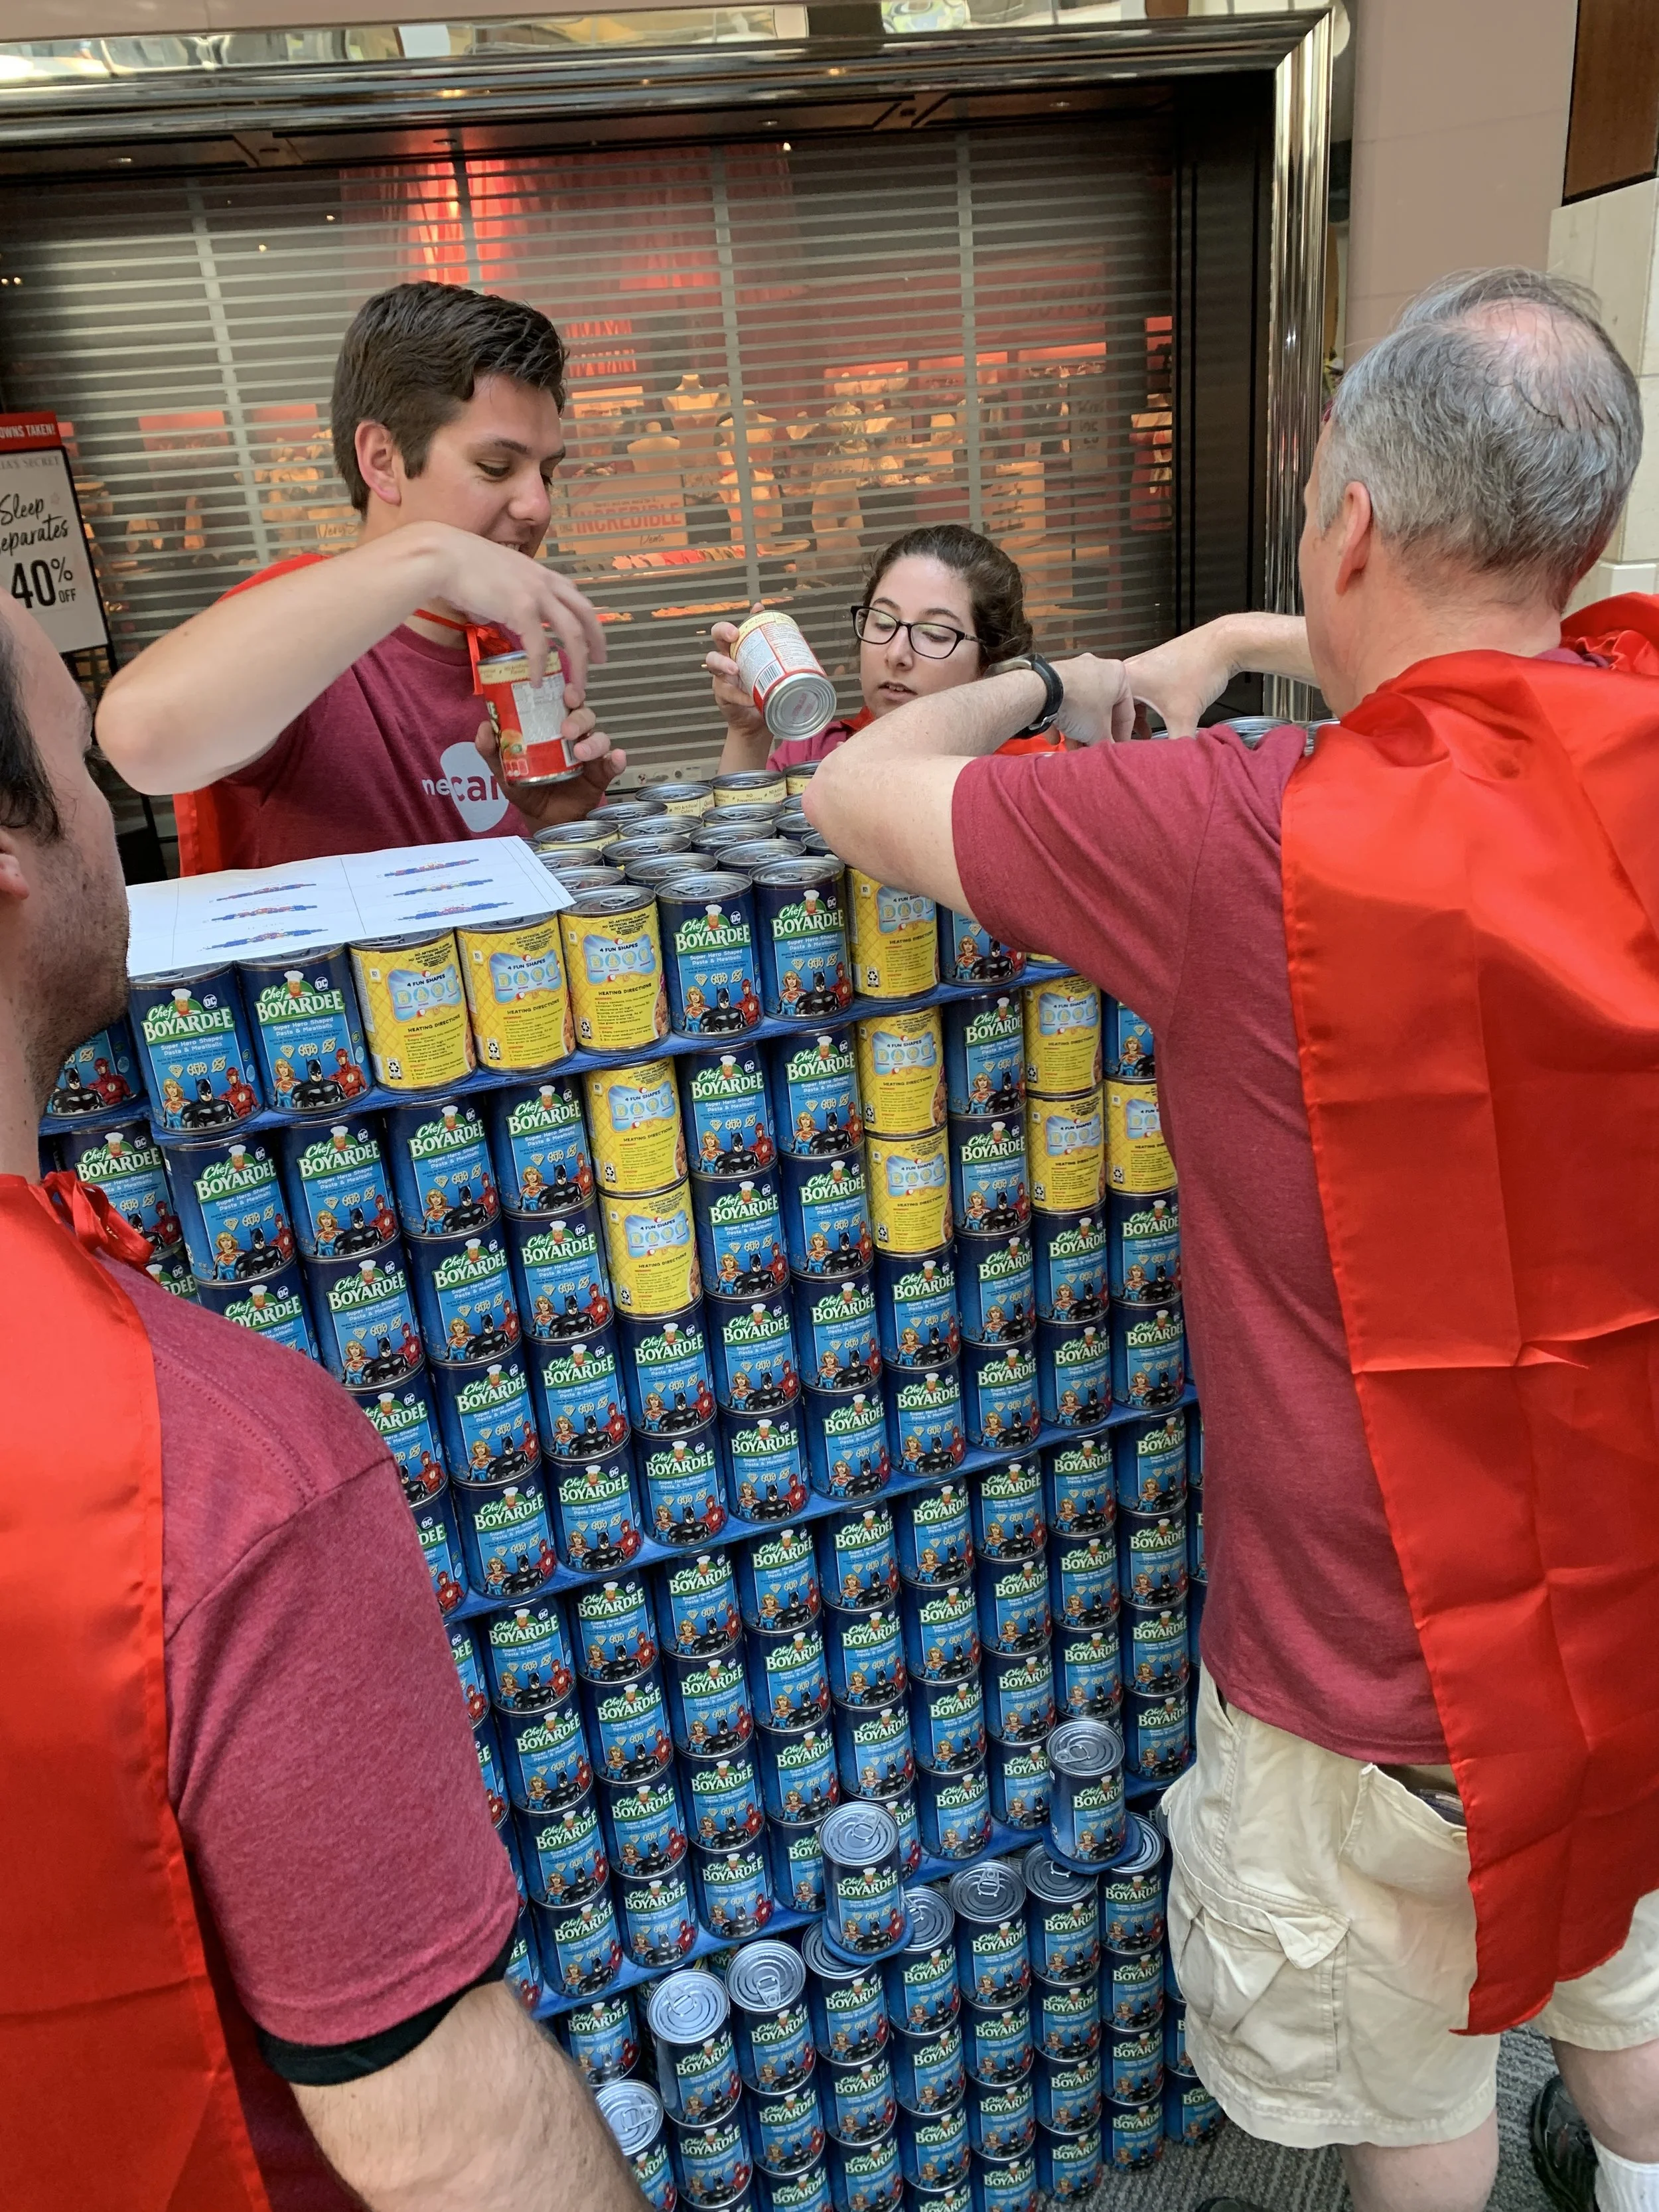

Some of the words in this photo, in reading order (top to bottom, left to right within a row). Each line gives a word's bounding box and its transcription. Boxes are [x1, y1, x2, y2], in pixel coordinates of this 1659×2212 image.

[25, 423, 56, 437] TAKEN!
[0, 493, 44, 526] Sleep
[0, 516, 68, 556] eparates
[58, 588, 76, 604] OFF
[772, 910, 844, 938] BOYARDEE
[779, 905, 803, 919] Chef
[676, 924, 751, 952] BOYARDEE
[682, 920, 705, 933] Chef
[526, 958, 545, 968] SHAPES
[426, 974, 445, 983] SHAPES
[623, 983, 652, 993] DIRECTIONS
[255, 991, 344, 1023] BOYARDEE
[261, 988, 285, 1002] Chef
[533, 999, 559, 1010] DIRECTIONS
[143, 1008, 234, 1043] BOYARDEE
[148, 1006, 173, 1021] Chef
[435, 1014, 461, 1027] DIRECTIONS
[787, 1053, 855, 1081] BOYARDEE
[794, 1051, 816, 1063] Chef
[691, 1072, 763, 1099] BOYARDEE
[698, 1069, 719, 1082] Chef
[508, 1100, 581, 1136] BOYARDEE
[515, 1102, 540, 1116] Chef
[409, 1120, 484, 1158] BOYARDEE
[417, 1124, 443, 1138] Chef
[968, 1136, 989, 1147] Chef
[83, 1151, 106, 1164] Chef
[299, 1140, 380, 1177] BOYARDEE
[305, 1145, 332, 1158] Chef
[962, 1139, 1025, 1162] BOYARDEE
[78, 1150, 161, 1182] BOYARDEE
[203, 1165, 230, 1180] Chef
[196, 1160, 276, 1201] BOYARDEE
[801, 1174, 865, 1203] BOYARDEE
[710, 1195, 778, 1223] BOYARDEE
[1122, 1217, 1179, 1237] BOYARDE
[523, 1234, 597, 1265] BOYARDEE
[528, 1235, 549, 1248] Chef
[434, 1249, 507, 1288] BOYARDEE
[328, 1271, 407, 1310] BOYARDEE
[335, 1278, 360, 1291] Chef
[894, 1274, 954, 1300] BOYARDEE
[229, 1296, 301, 1327] OYARDEE
[812, 1295, 875, 1323] BOYARDEE
[723, 1315, 790, 1343] BOYARDEE
[635, 1333, 704, 1364] BOYARDEE
[543, 1355, 615, 1386] BOYARDEE
[978, 1357, 1036, 1385] BOYARDEE
[457, 1370, 527, 1413] BOYARDEE
[897, 1384, 960, 1408] BOYARDEE
[825, 1406, 885, 1434] BOYARDEE
[732, 1430, 798, 1453] BOYARDEE
[647, 1451, 715, 1477] BOYARDEE
[1054, 1449, 1112, 1473] BOYARDEE
[560, 1474, 628, 1502] BOYARDEE
[981, 1473, 1041, 1497] BOYARDEE
[474, 1493, 544, 1530] BOYARDEE
[914, 1494, 969, 1524] BOYARDEE
[835, 1516, 893, 1548] BOYARDEE
[1131, 1529, 1185, 1548] BOYARDEE
[753, 1535, 813, 1568] BOYARDEE
[1062, 1547, 1116, 1571] BOYARDEE
[670, 1561, 732, 1594] BOYARDEE
[577, 1589, 644, 1617] BOYARDEE
[920, 1593, 975, 1622] BOYARDEE
[489, 1615, 559, 1645] BOYARDEE
[843, 1617, 900, 1647] BOYARDEE
[766, 1637, 822, 1670] BOYARDEE
[1064, 1638, 1119, 1662] BOYARDEE
[682, 1664, 743, 1695] BOYARDEE
[999, 1658, 1052, 1689] BOYARDEE
[598, 1686, 662, 1720] BOYARDEE
[518, 1712, 580, 1752] BOYARDEE
[854, 1715, 908, 1743] BOYARDEE
[777, 1733, 833, 1767] BOYARDEE
[692, 1765, 753, 1791] BOYARDEE
[612, 1789, 675, 1818] BOYARDEE
[536, 1811, 597, 1850] BOYARDEE
[703, 1858, 763, 1882] BOYARDEE
[837, 1872, 898, 1895] BOYARDEE
[625, 1883, 686, 1909] BOYARDEE
[555, 1904, 613, 1941] BOYARDEE
